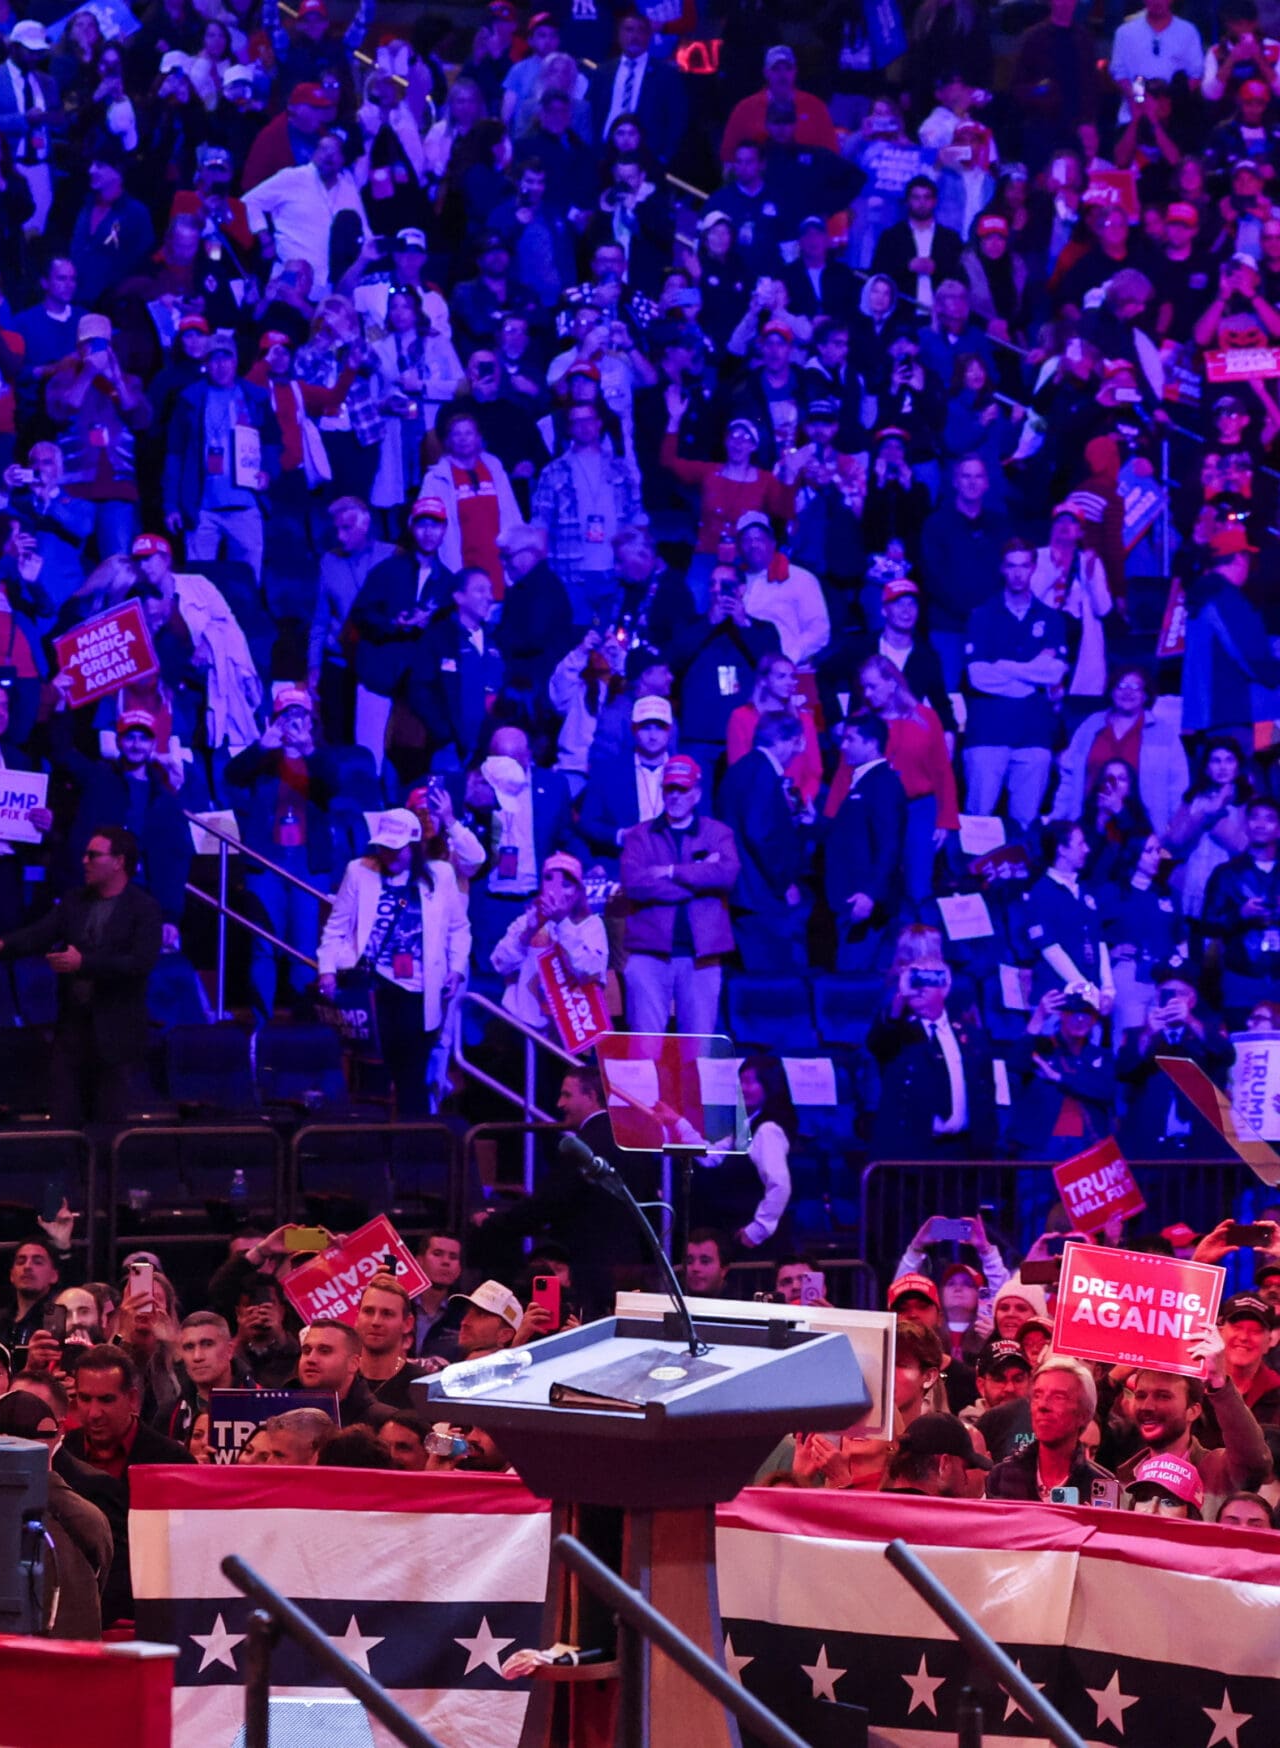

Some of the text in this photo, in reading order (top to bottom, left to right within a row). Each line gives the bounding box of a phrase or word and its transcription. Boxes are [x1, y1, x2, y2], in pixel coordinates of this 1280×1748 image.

[69, 629, 136, 668] AMERICA
[77, 620, 119, 650] MAKE
[80, 646, 129, 677] GREAT
[86, 658, 138, 692] AGAIN!
[0, 808, 21, 821] FIX
[1248, 1050, 1269, 1132] TRUMP
[1071, 1195, 1105, 1218] WILL
[307, 1242, 390, 1310] AGAIN!
[1071, 1275, 1155, 1305] DREAM
[1160, 1289, 1207, 1317] BIG,
[1071, 1297, 1194, 1341] AGAIN!
[1117, 1352, 1144, 1363] 2024
[1159, 1460, 1191, 1481] AMERICA
